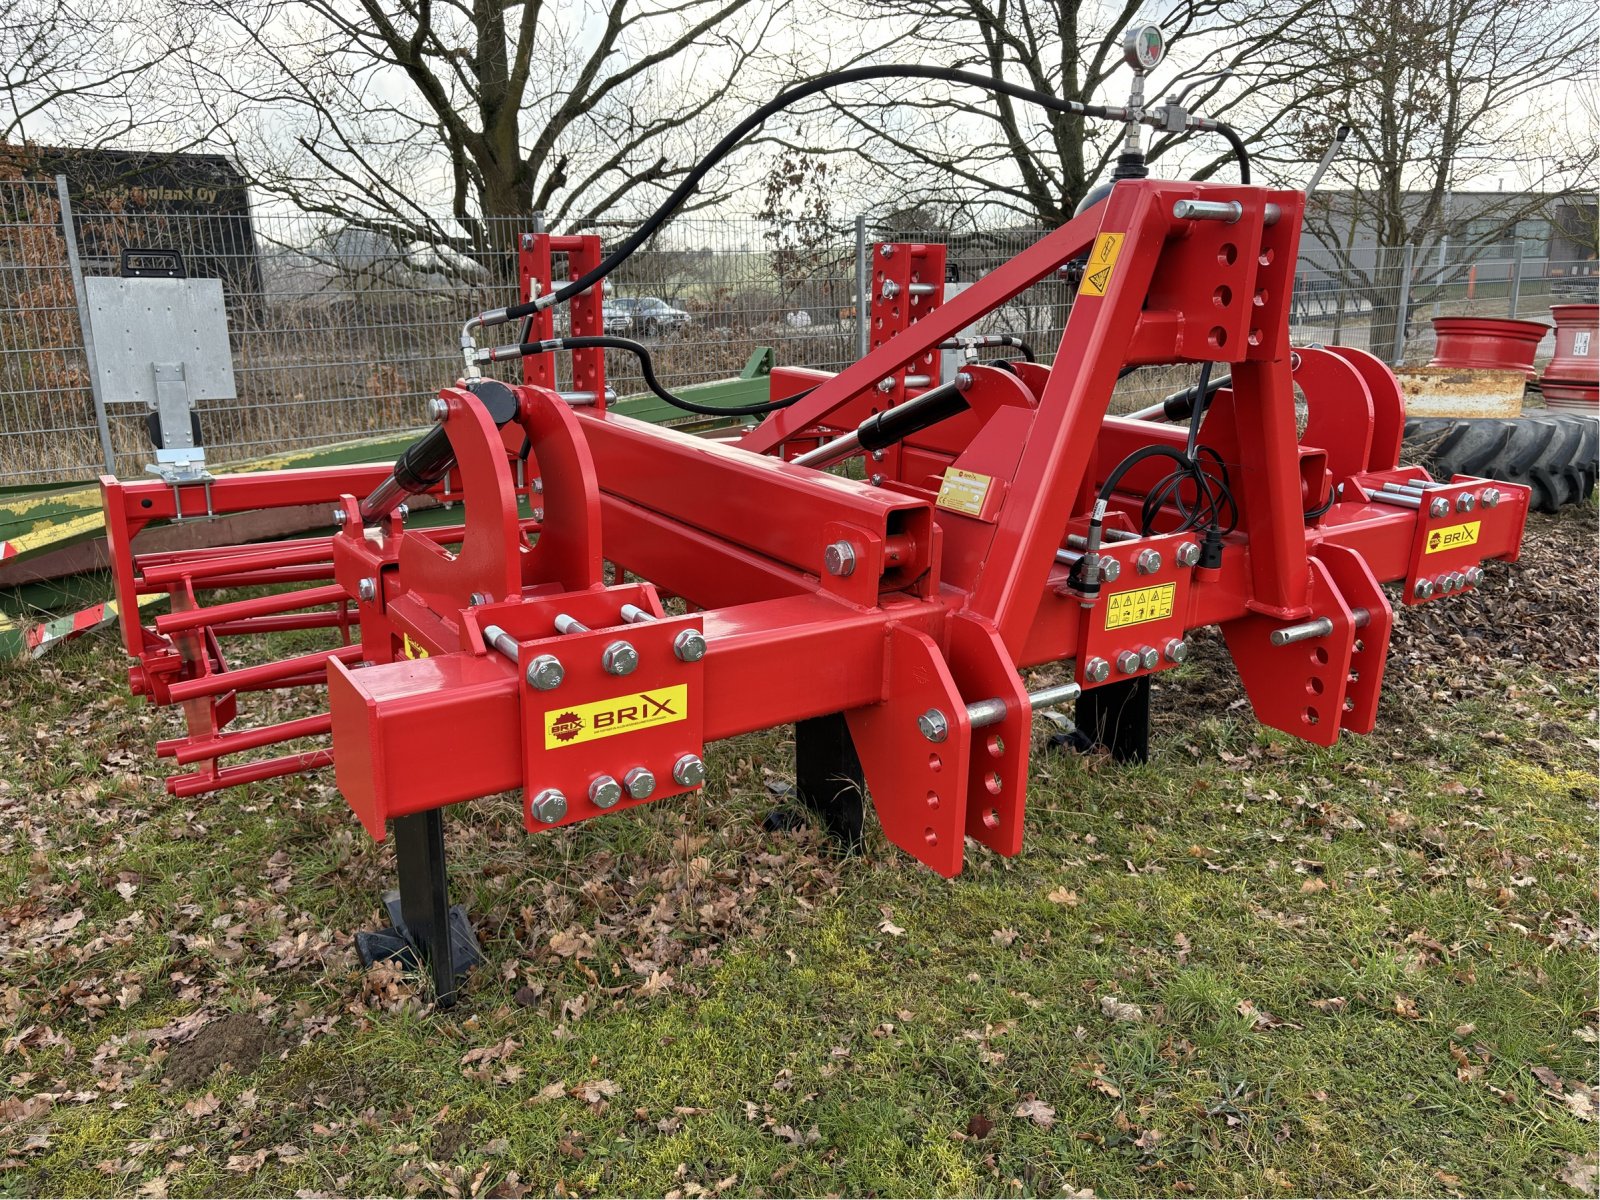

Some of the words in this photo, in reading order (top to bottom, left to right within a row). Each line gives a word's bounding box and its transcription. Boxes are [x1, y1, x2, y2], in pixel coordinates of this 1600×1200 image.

[196, 187, 217, 204] Oy
[1443, 525, 1474, 544] BRIX
[594, 694, 677, 729] BRIX
[551, 720, 584, 734] BRIX
